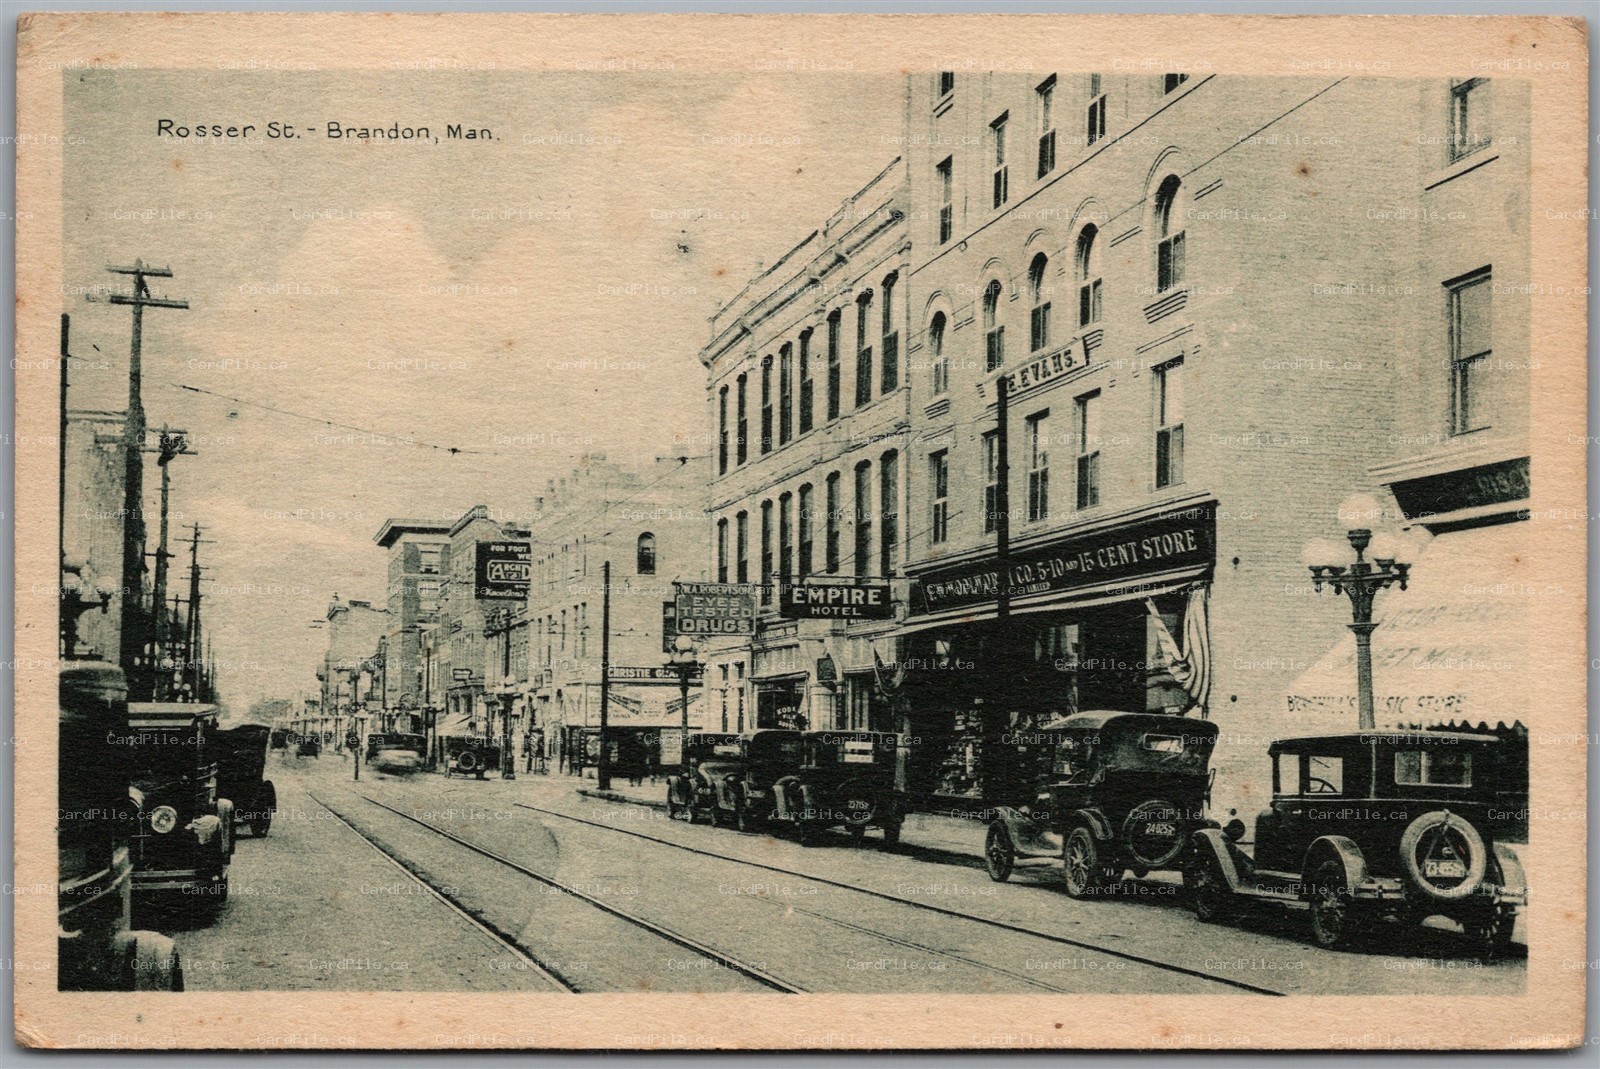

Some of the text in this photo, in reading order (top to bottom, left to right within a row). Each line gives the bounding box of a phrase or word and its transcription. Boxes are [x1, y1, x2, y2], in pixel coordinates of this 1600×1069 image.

[508, 545, 527, 553] FOOT
[1016, 564, 1036, 584] CO.
[1078, 552, 1095, 573] 15
[1097, 541, 1139, 569] CENT
[1141, 529, 1198, 560] STORE
[693, 596, 740, 608] EYES
[792, 587, 882, 605] EMPIRE
[681, 606, 752, 618] TESTED
[811, 606, 861, 616] HOTEL
[682, 619, 750, 632] DRUGS
[607, 667, 651, 678] CHRISTIE
